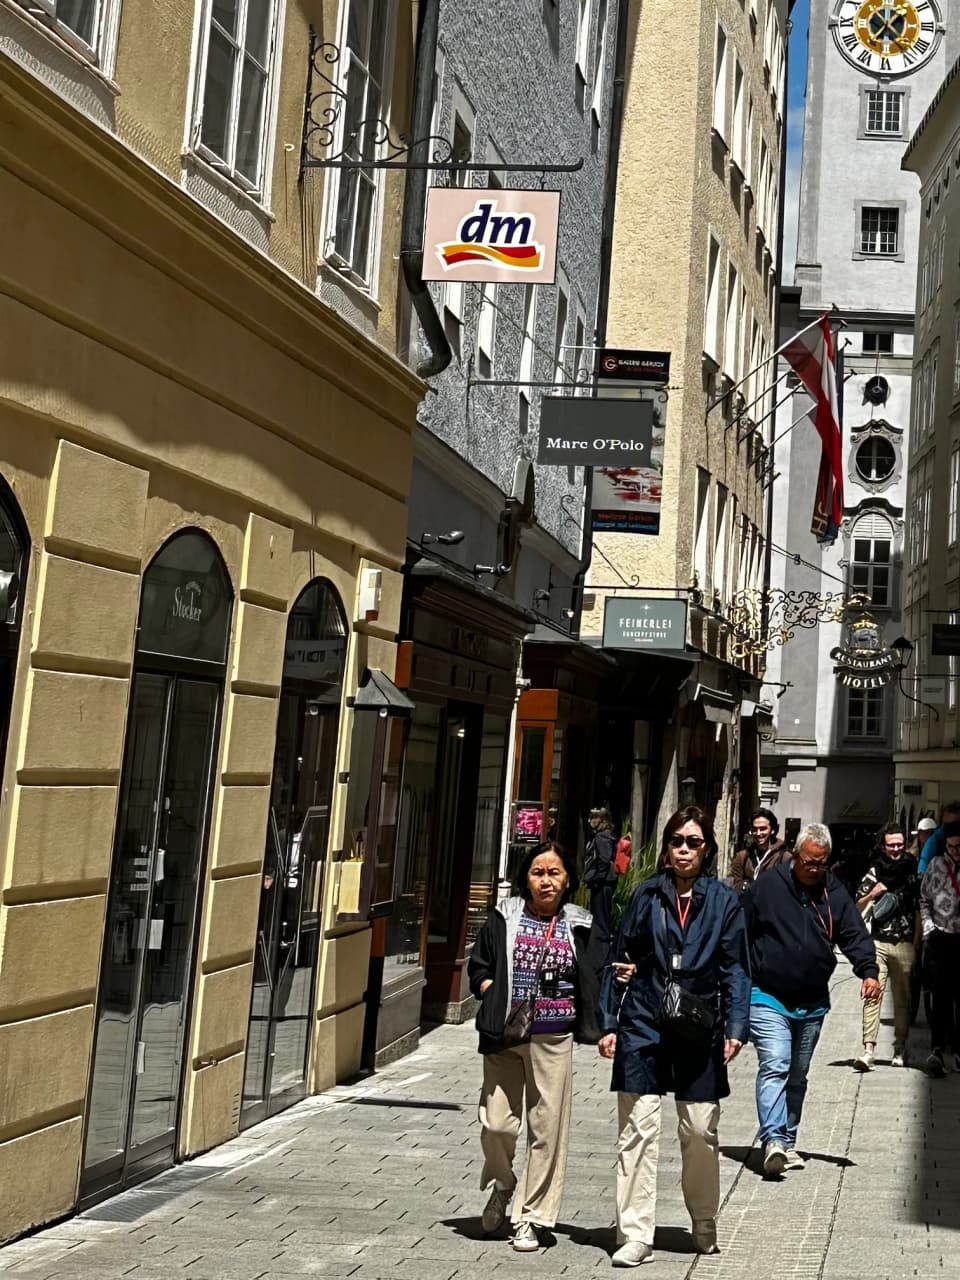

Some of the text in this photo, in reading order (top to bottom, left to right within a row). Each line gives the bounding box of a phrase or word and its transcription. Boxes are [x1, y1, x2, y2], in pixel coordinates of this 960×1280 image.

[460, 202, 534, 246] dm
[546, 436, 645, 453] Marc O'Polo
[835, 652, 893, 668] RESTAURANT
[842, 675, 886, 689] HOTEL
